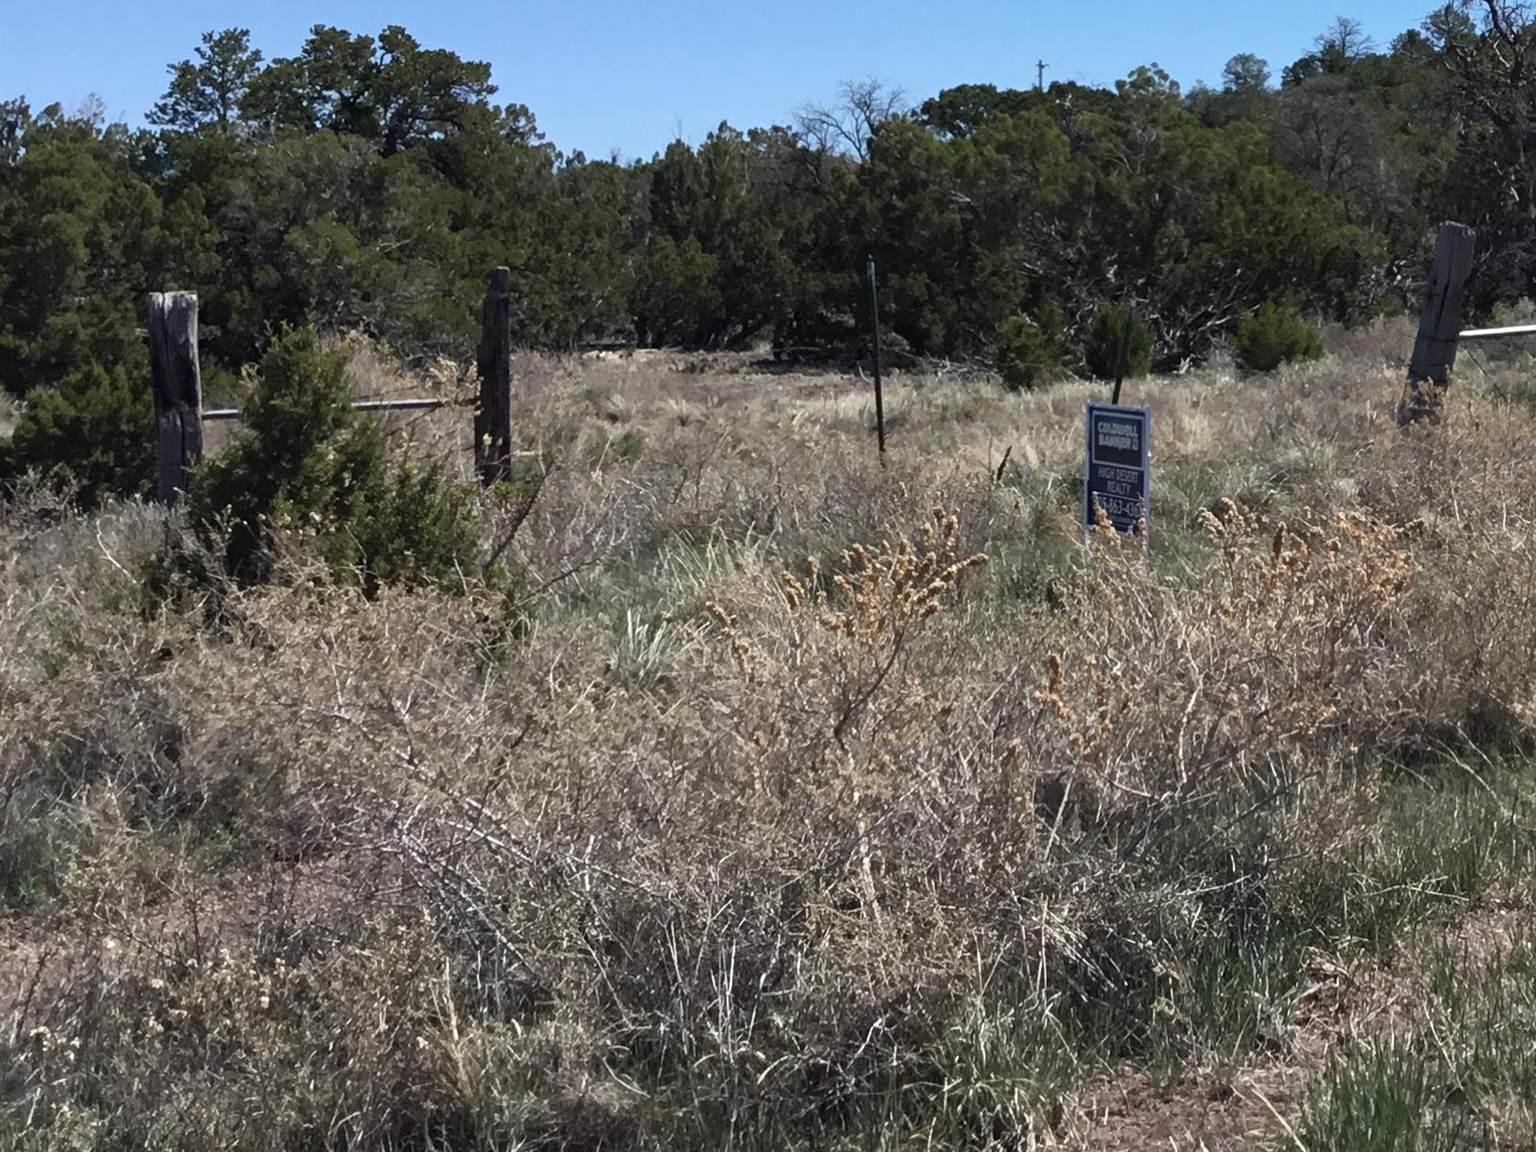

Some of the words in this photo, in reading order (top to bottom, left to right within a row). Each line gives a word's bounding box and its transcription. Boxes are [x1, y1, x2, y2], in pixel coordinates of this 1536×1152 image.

[1098, 467, 1115, 479] HIGH
[1116, 468, 1139, 483] DESERT
[1107, 480, 1131, 495] REALTY
